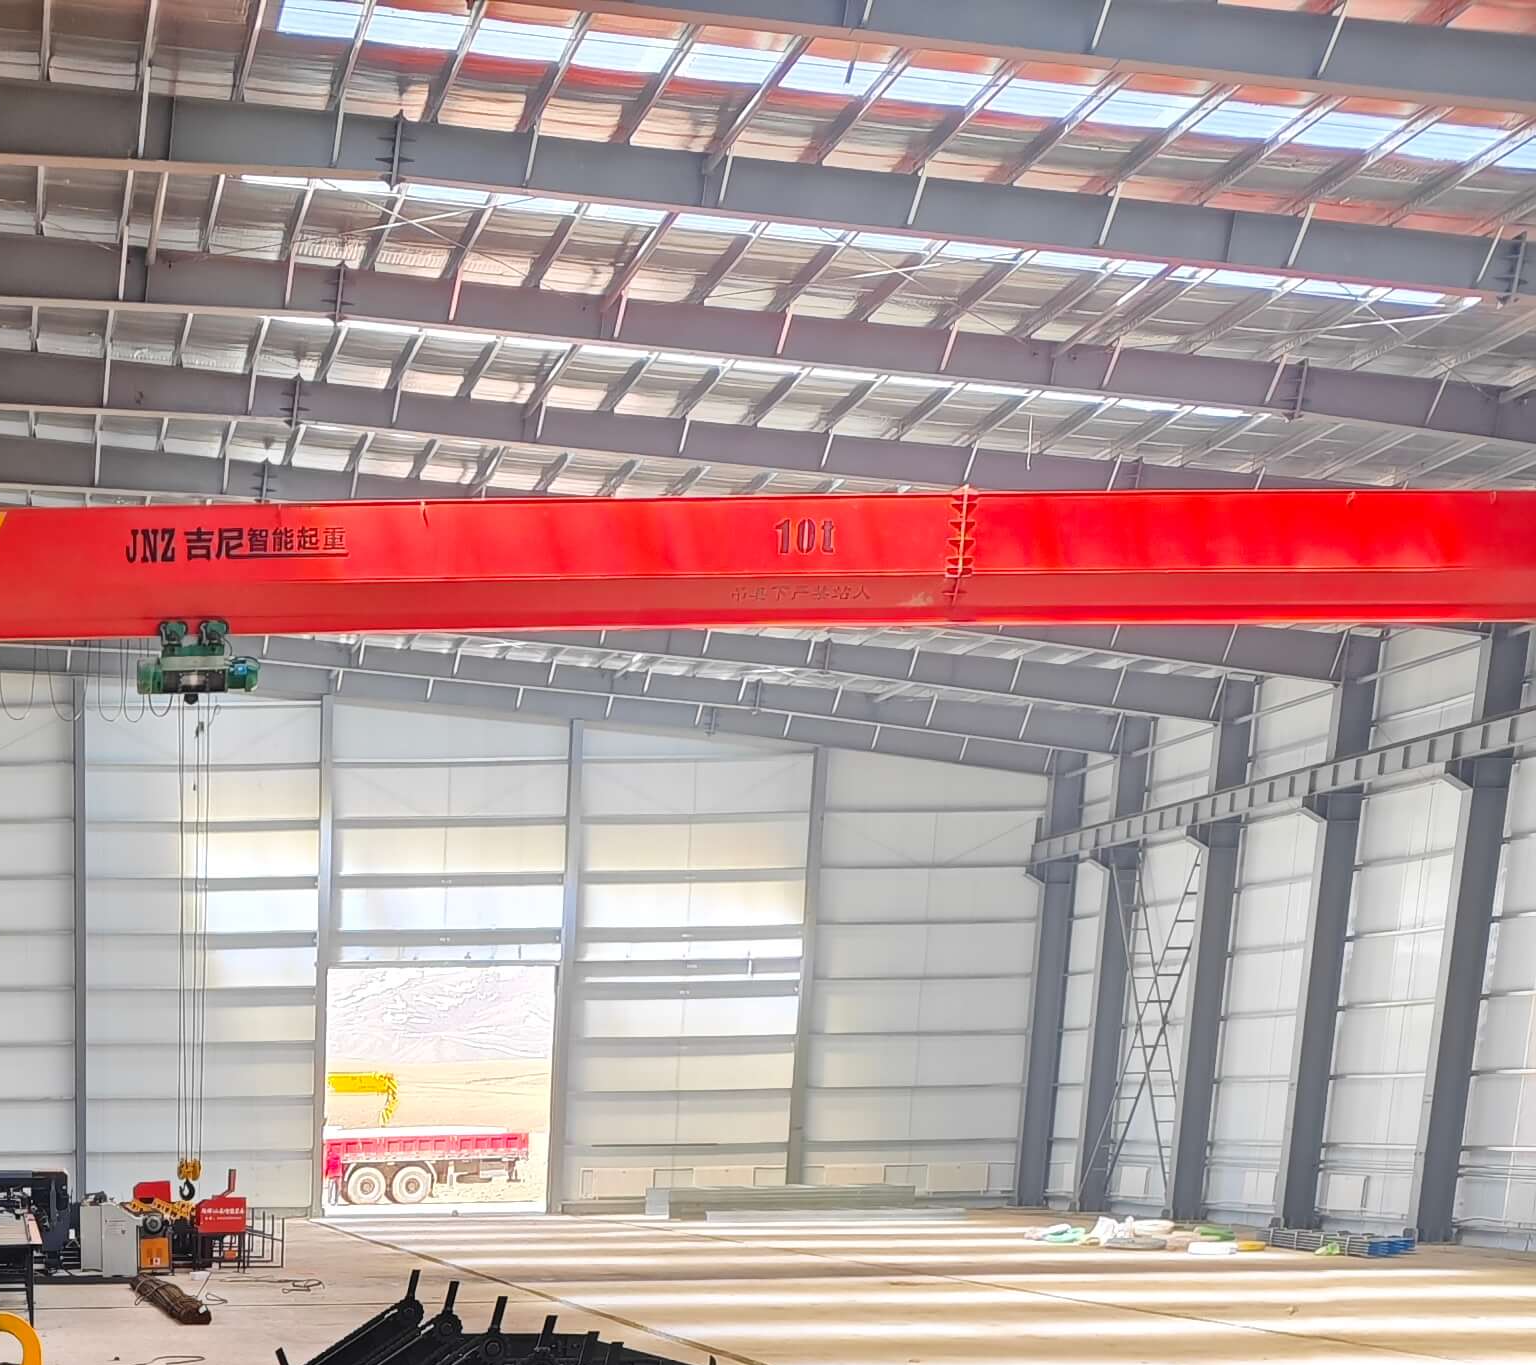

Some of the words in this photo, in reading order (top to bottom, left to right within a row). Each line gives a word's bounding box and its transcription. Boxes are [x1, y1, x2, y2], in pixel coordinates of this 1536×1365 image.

[125, 528, 176, 564] JNZ
[183, 526, 347, 561] 吉尼智能起重
[774, 518, 835, 554] 10t
